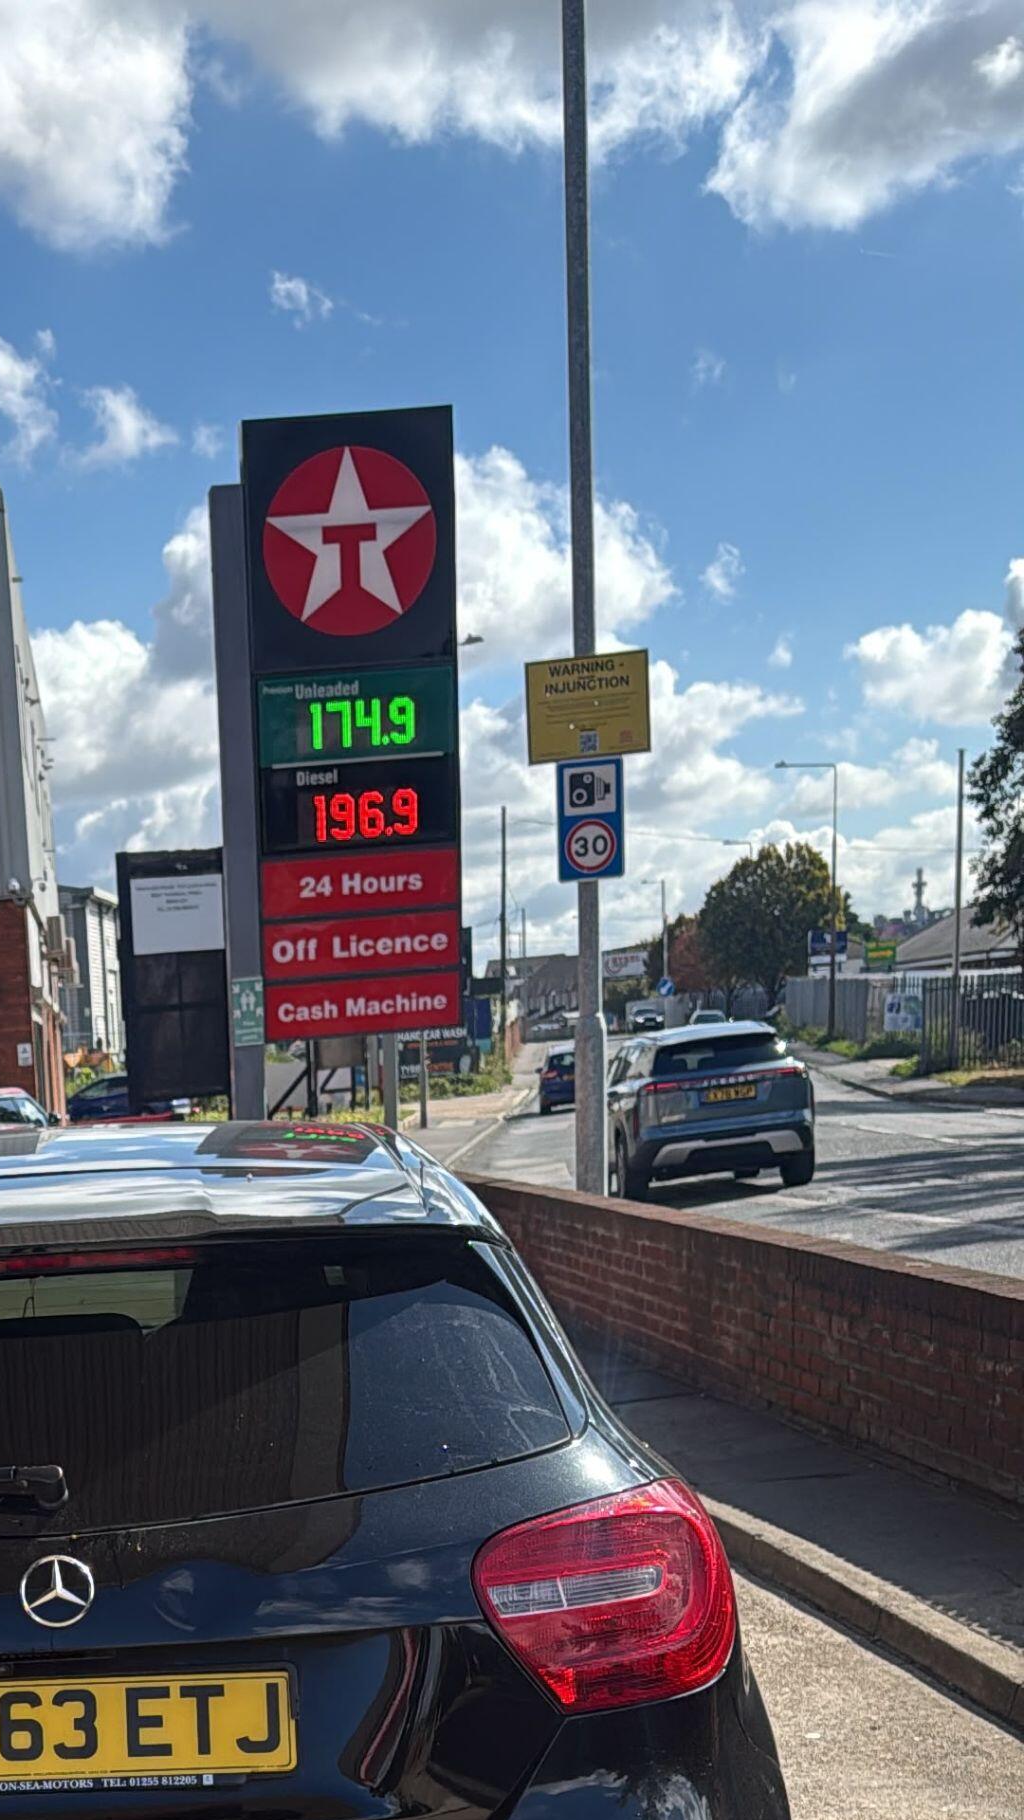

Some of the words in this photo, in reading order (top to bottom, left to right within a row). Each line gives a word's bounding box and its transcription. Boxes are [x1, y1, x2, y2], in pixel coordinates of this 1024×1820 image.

[547, 659, 614, 678] WARNING
[295, 680, 359, 699] Unleaded
[544, 675, 630, 694] INJUNCTION
[309, 696, 416, 750] 174.9
[296, 768, 339, 786] Diesel
[313, 787, 419, 842] 196.9
[573, 834, 609, 858] 30
[299, 875, 333, 898] 24
[341, 872, 424, 896] Hours
[272, 938, 318, 964] Off
[332, 932, 449, 959] Licence
[277, 1001, 338, 1023] Cash
[345, 992, 448, 1018] Machine
[124, 1682, 282, 1758] ETJ
[101, 1777, 127, 1789] TEL:
[129, 1775, 159, 1787] 01255
[161, 1774, 198, 1786] 812205
